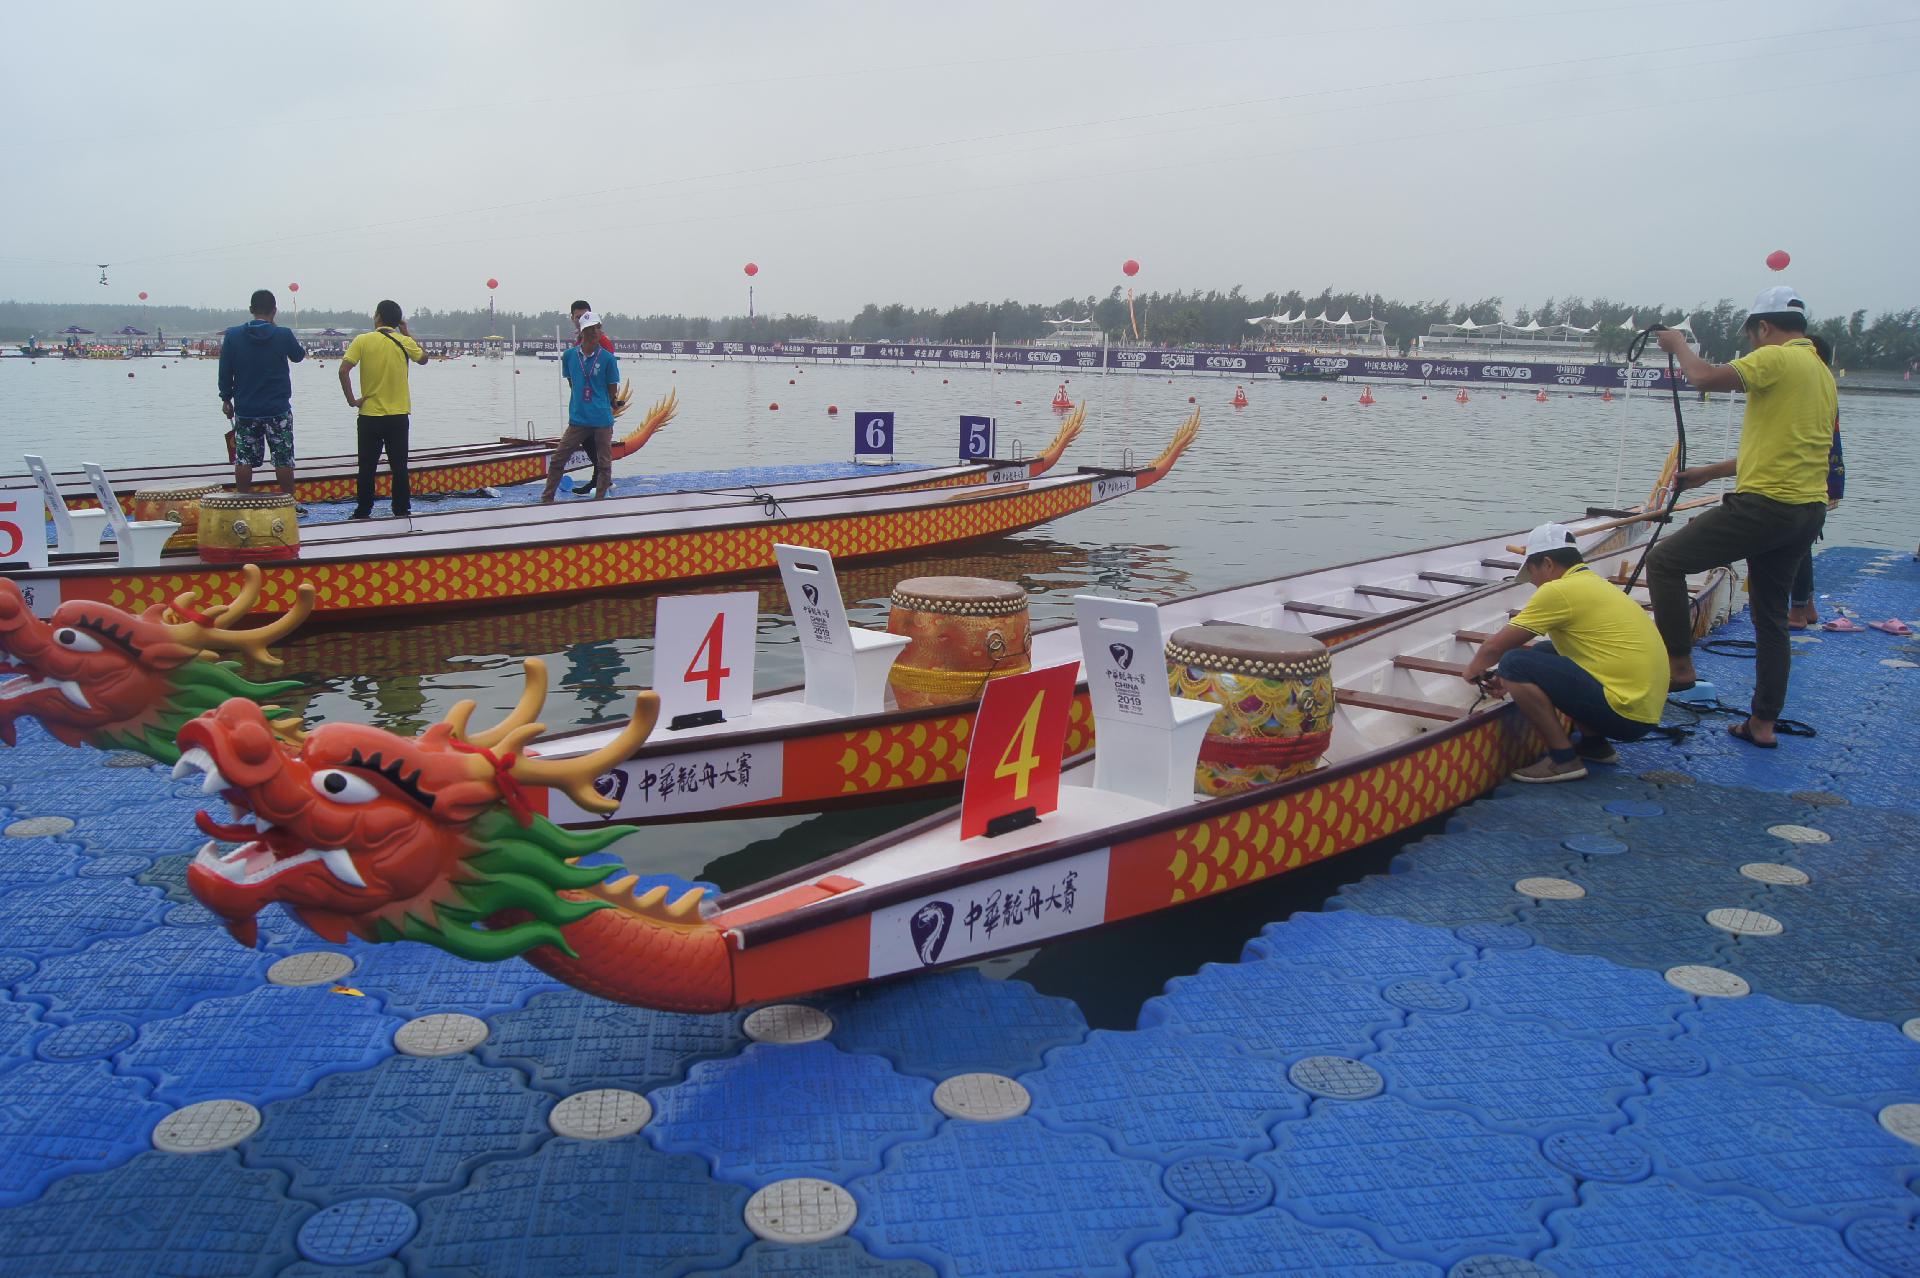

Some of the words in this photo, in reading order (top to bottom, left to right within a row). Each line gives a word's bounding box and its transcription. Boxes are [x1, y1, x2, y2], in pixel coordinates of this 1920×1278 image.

[1207, 357, 1246, 368] CCTV5
[1482, 366, 1532, 379] CCTV5
[1558, 376, 1582, 384] CCTV
[866, 419, 886, 448] 6
[968, 424, 986, 455] 5
[0, 501, 23, 558] 5
[684, 612, 731, 702] 4
[1114, 681, 1139, 691] CHINA
[1117, 694, 1142, 706] 2019
[994, 689, 1046, 801] 4
